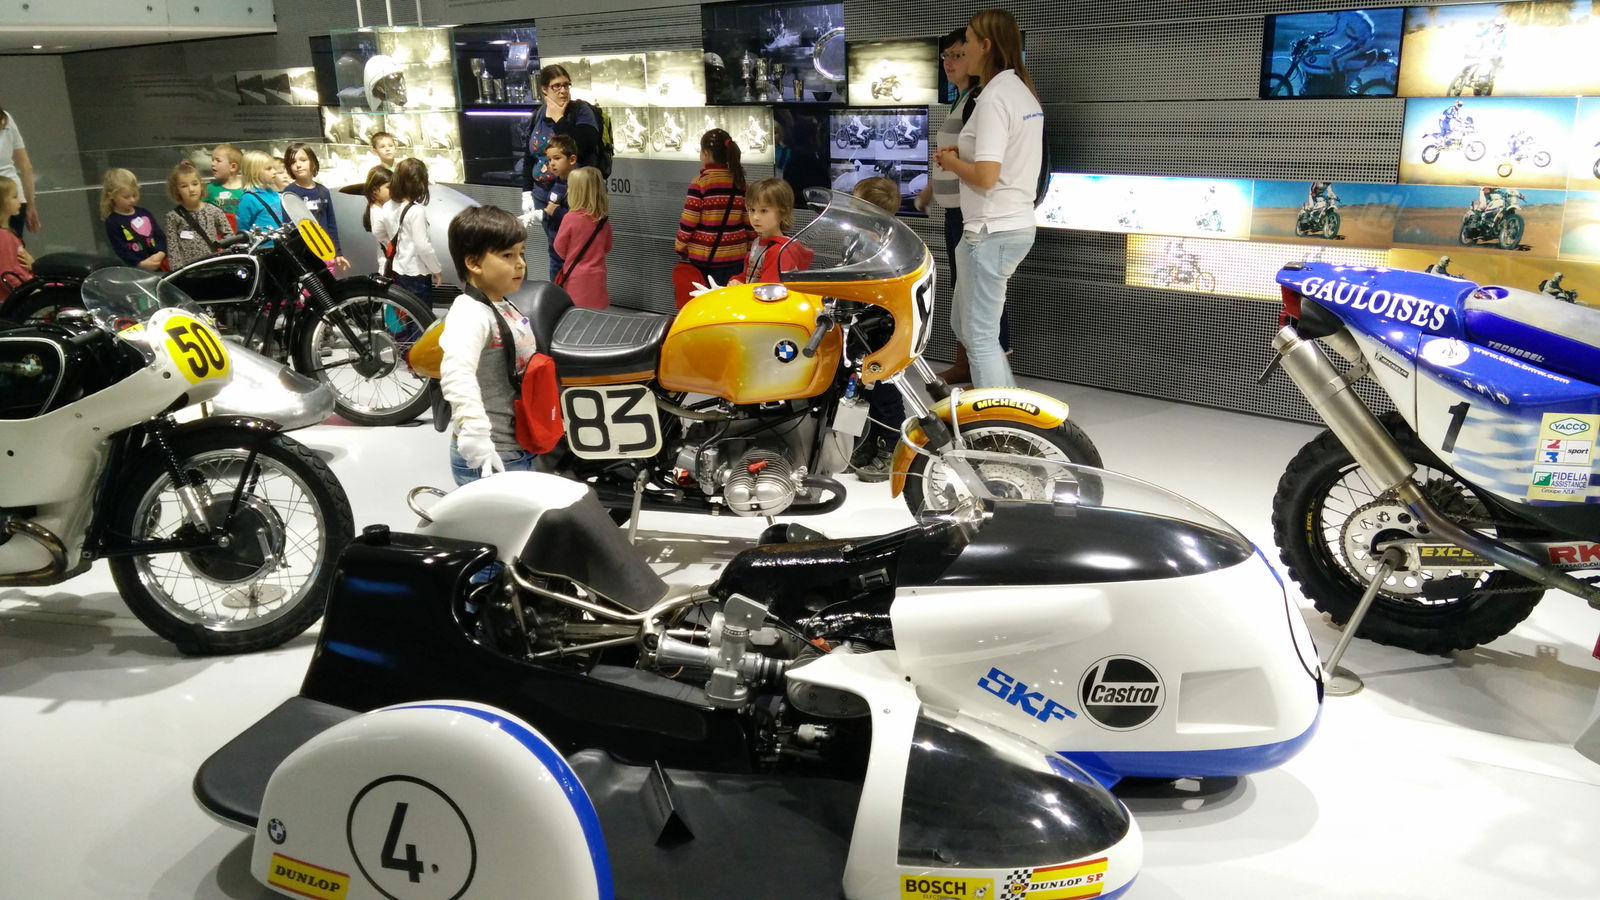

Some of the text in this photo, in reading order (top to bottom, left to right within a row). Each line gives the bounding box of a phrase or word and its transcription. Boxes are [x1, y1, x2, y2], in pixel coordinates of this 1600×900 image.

[610, 178, 631, 194] 500
[1300, 276, 1450, 331] GAULOISES
[165, 321, 226, 379] 50
[976, 398, 1038, 414] MICHELIN
[564, 387, 657, 453] 83
[1441, 401, 1471, 454] 1
[1553, 423, 1588, 431] YACCO
[1550, 480, 1588, 489] ASSISTANCE
[1552, 471, 1588, 482] FIDELIA
[1420, 547, 1481, 558] EXCE
[1548, 543, 1600, 565] RK
[977, 666, 1078, 723] SKF
[1090, 684, 1160, 704] Castrol
[274, 864, 341, 893] DUNLOP
[905, 879, 967, 896] BOSCH
[1029, 872, 1105, 891] DUNLOP SP
